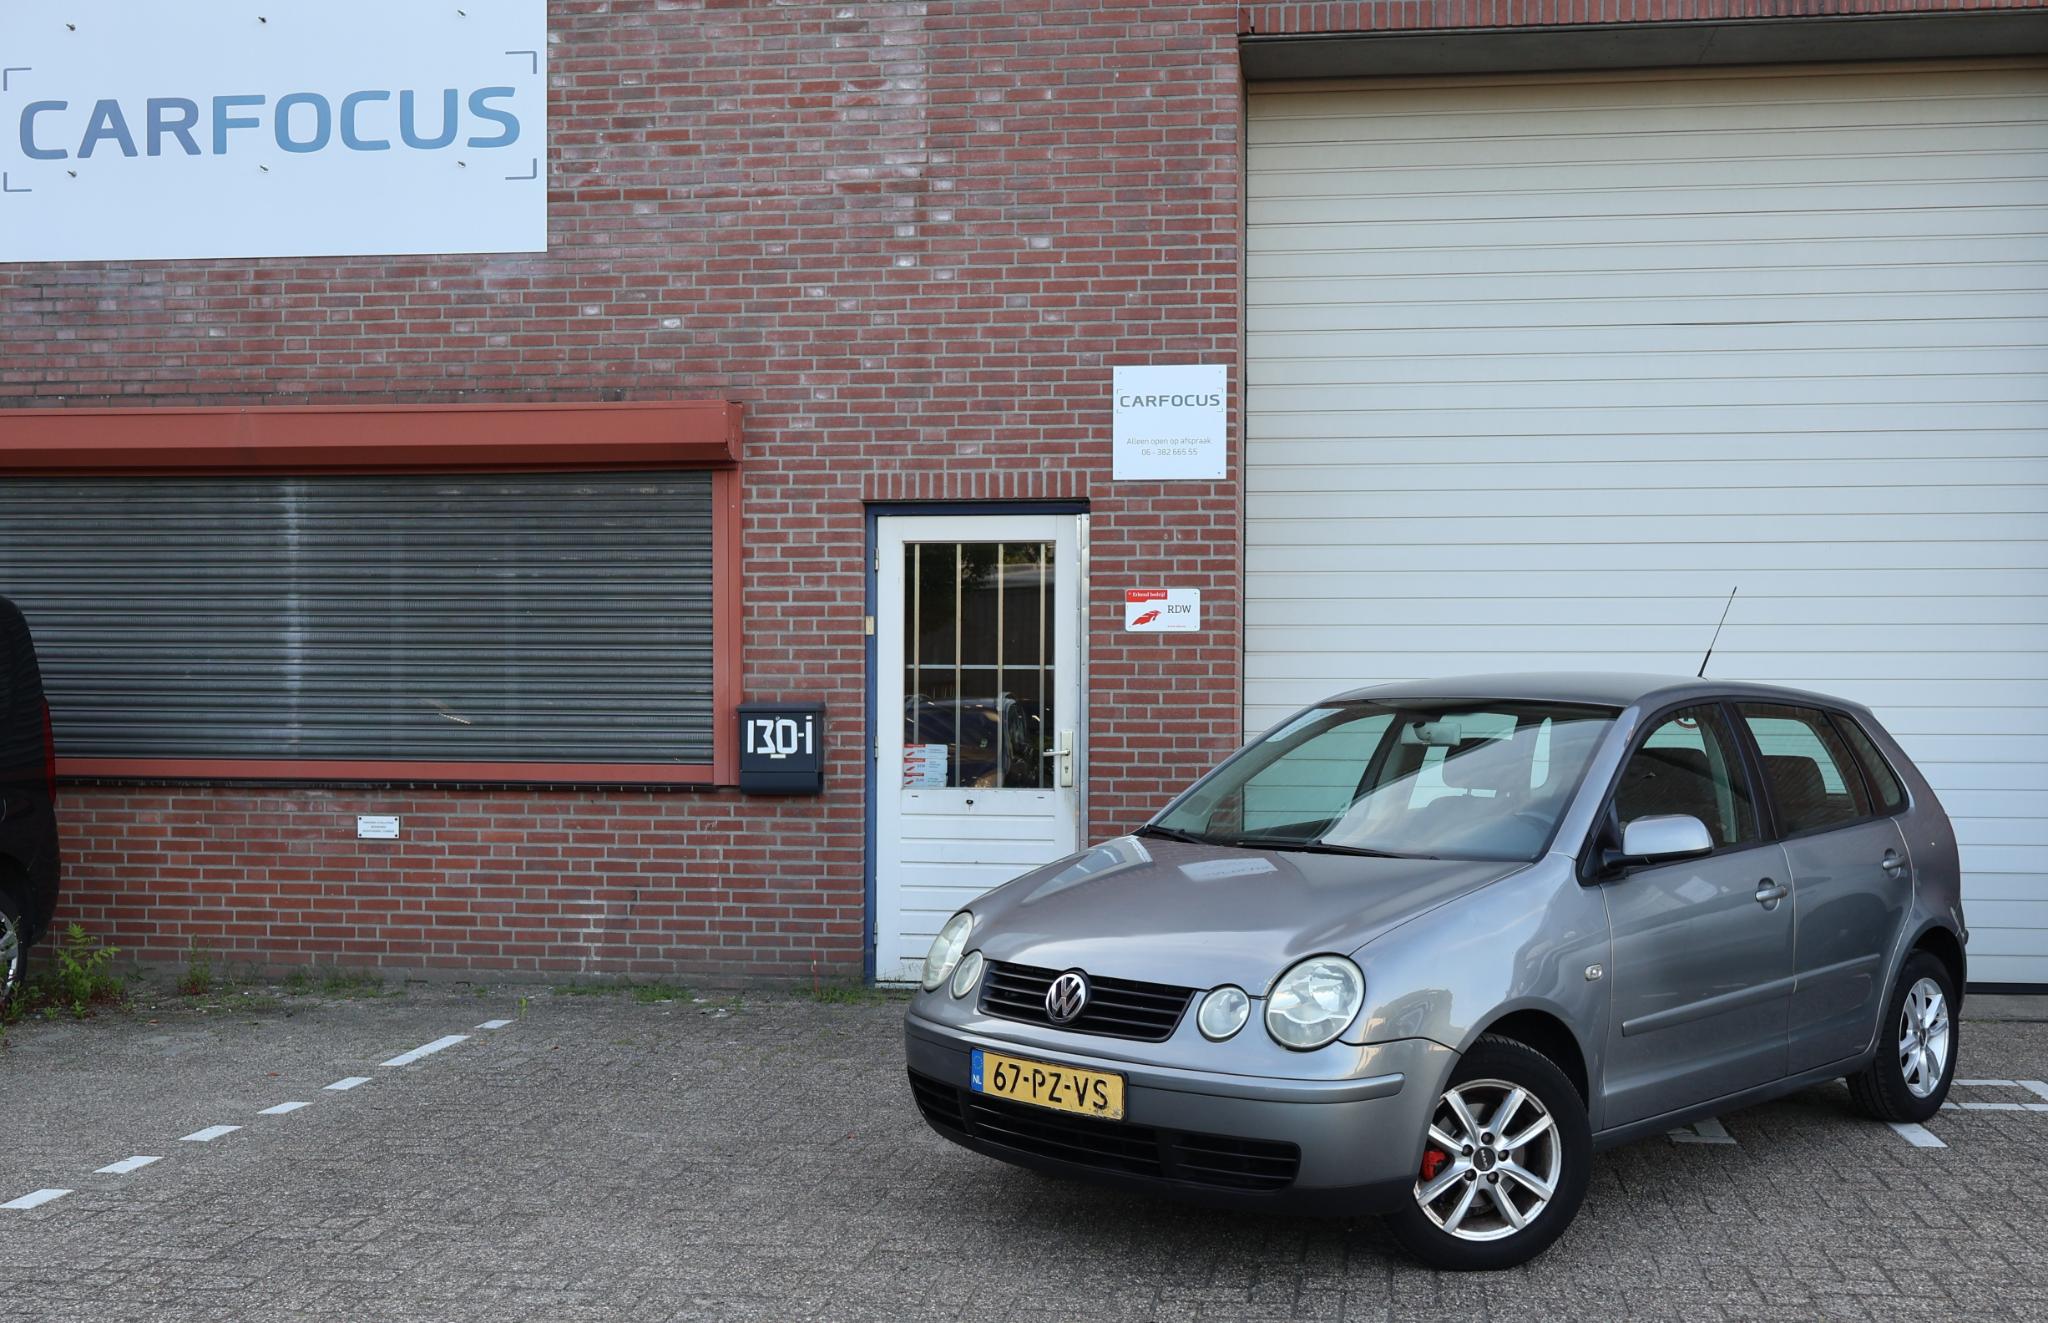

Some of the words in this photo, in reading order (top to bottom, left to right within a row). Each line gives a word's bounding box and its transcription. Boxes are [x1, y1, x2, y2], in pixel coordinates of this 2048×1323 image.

[19, 86, 521, 161] CARFOCUS
[1120, 394, 1221, 408] CARFOCUS
[1150, 438, 1169, 446] open
[1169, 438, 1179, 446] op
[1167, 604, 1192, 614] RDW
[972, 1074, 982, 1085] NL
[993, 1062, 1109, 1110] 67-PZ-VS
